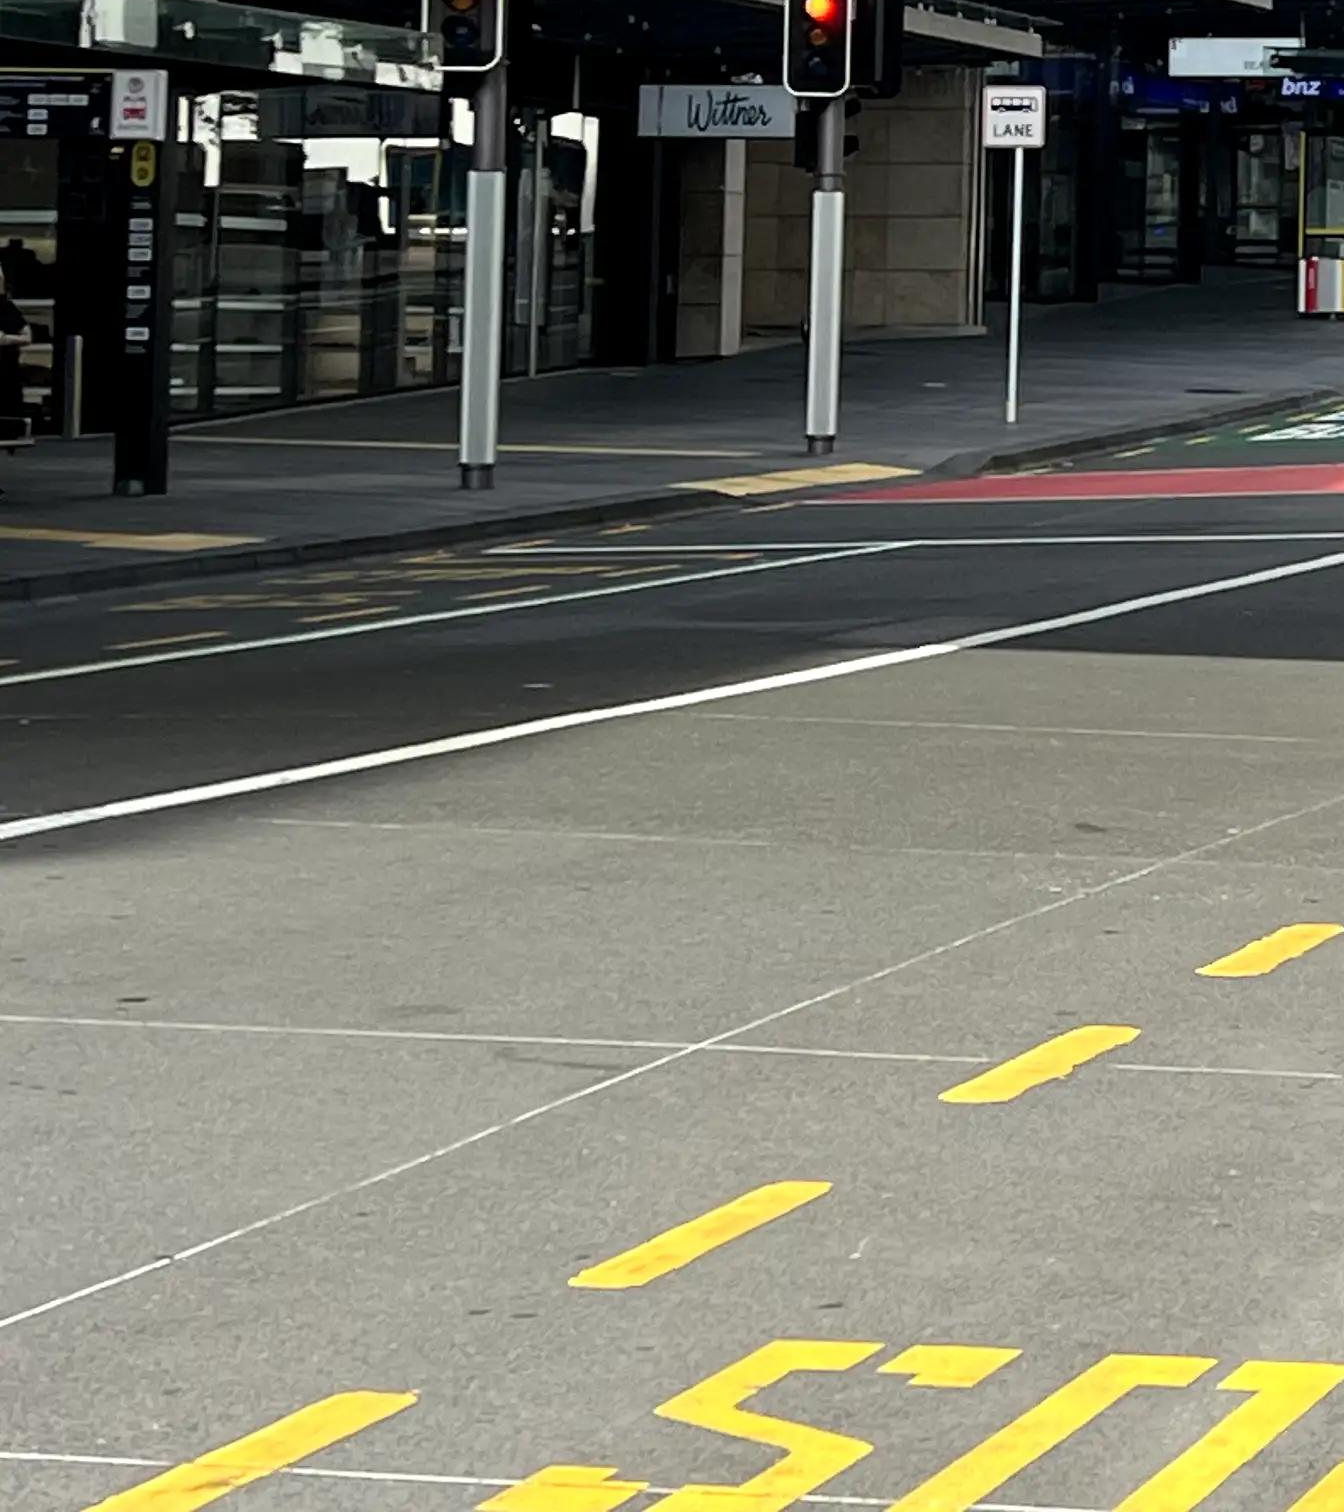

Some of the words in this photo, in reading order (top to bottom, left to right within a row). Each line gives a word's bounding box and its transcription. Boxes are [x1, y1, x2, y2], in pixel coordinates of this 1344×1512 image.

[1281, 77, 1322, 96] bnz
[687, 89, 772, 132] Wittner
[992, 123, 1034, 138] LANE
